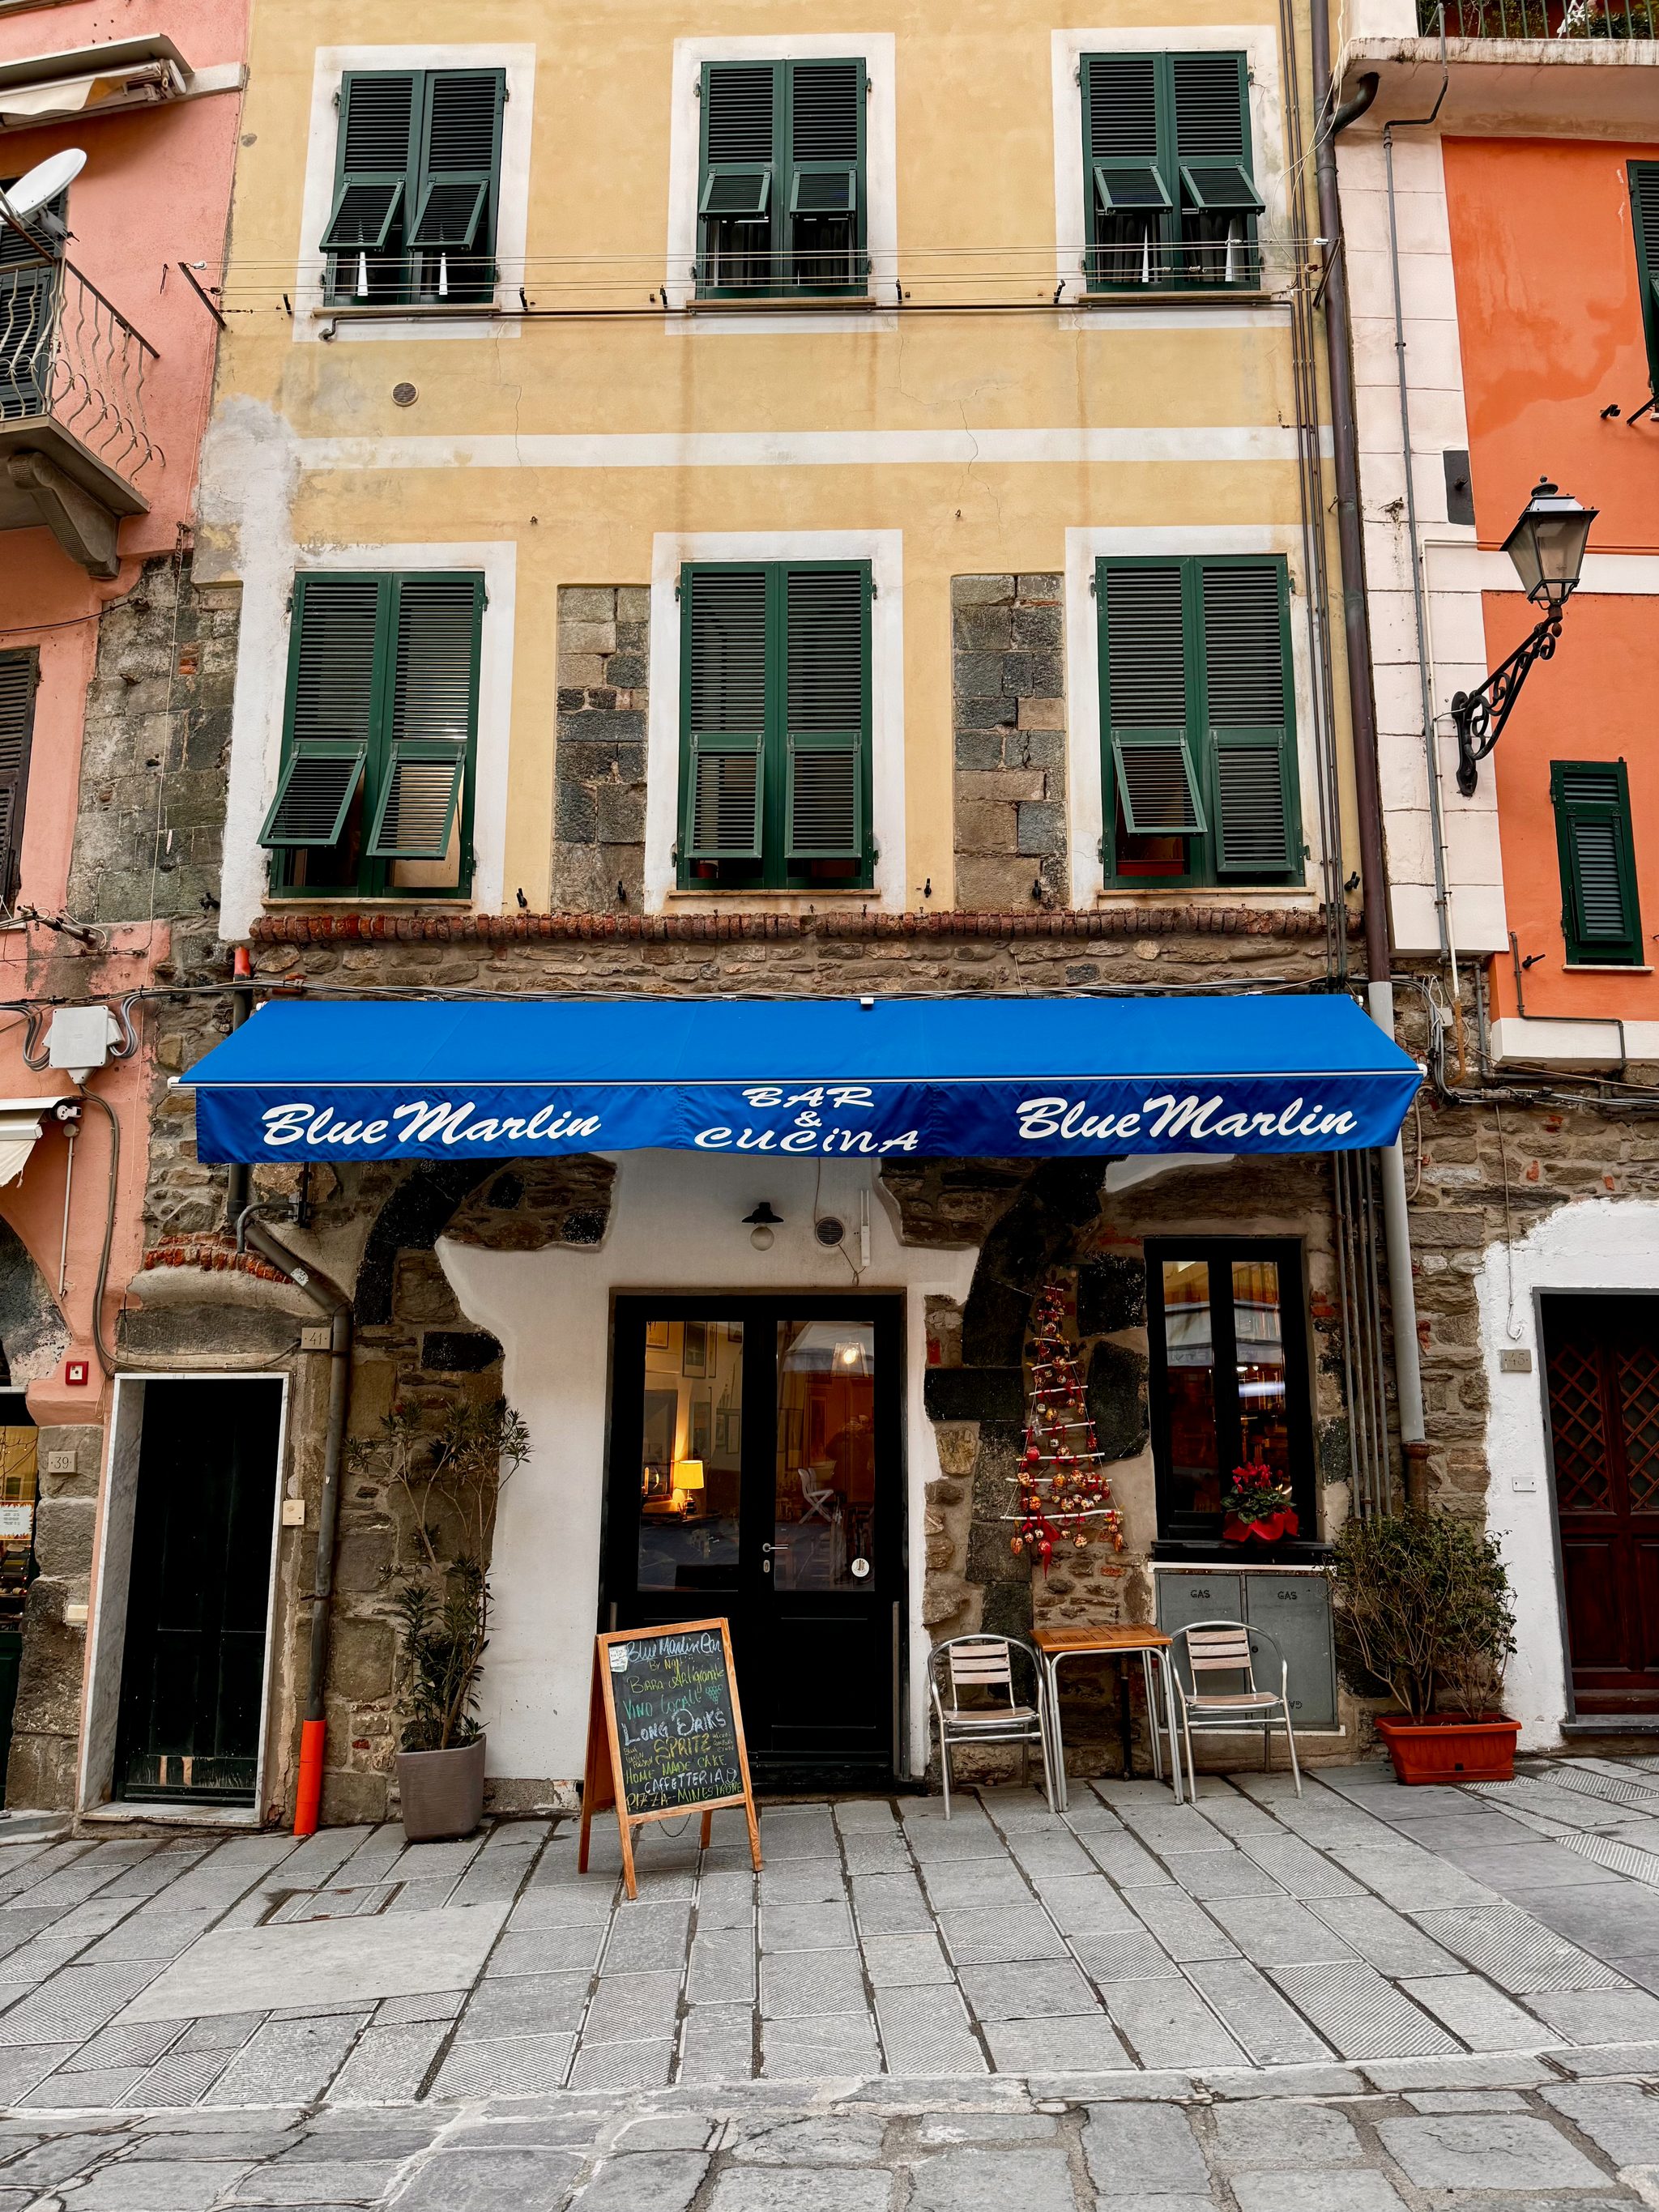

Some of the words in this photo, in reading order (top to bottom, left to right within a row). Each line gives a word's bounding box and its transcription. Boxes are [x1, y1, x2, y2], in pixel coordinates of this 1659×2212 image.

[741, 1086, 875, 1108] BAR
[261, 1103, 389, 1145] Blue
[392, 1100, 602, 1144] Marlin
[794, 1110, 823, 1127] &
[1016, 1097, 1141, 1139] Blue
[1142, 1094, 1358, 1139] Marlin
[309, 1332, 322, 1345] 41
[1508, 1353, 1525, 1366] 45
[54, 1456, 69, 1469] 39
[1190, 1589, 1211, 1599] GAS
[1277, 1591, 1298, 1600] GAS
[659, 1635, 701, 1656] Marlin
[622, 1698, 653, 1720] VINO
[621, 1720, 669, 1746] LONG
[654, 1732, 712, 1766] SPRITZ
[625, 1767, 655, 1785] HOME
[662, 1760, 692, 1776] MADE
[697, 1754, 727, 1768] CAKE
[644, 1767, 724, 1794] CAFFETTERIA
[625, 1790, 669, 1812] PIZZA
[677, 1781, 743, 1803] MINESTRONE
